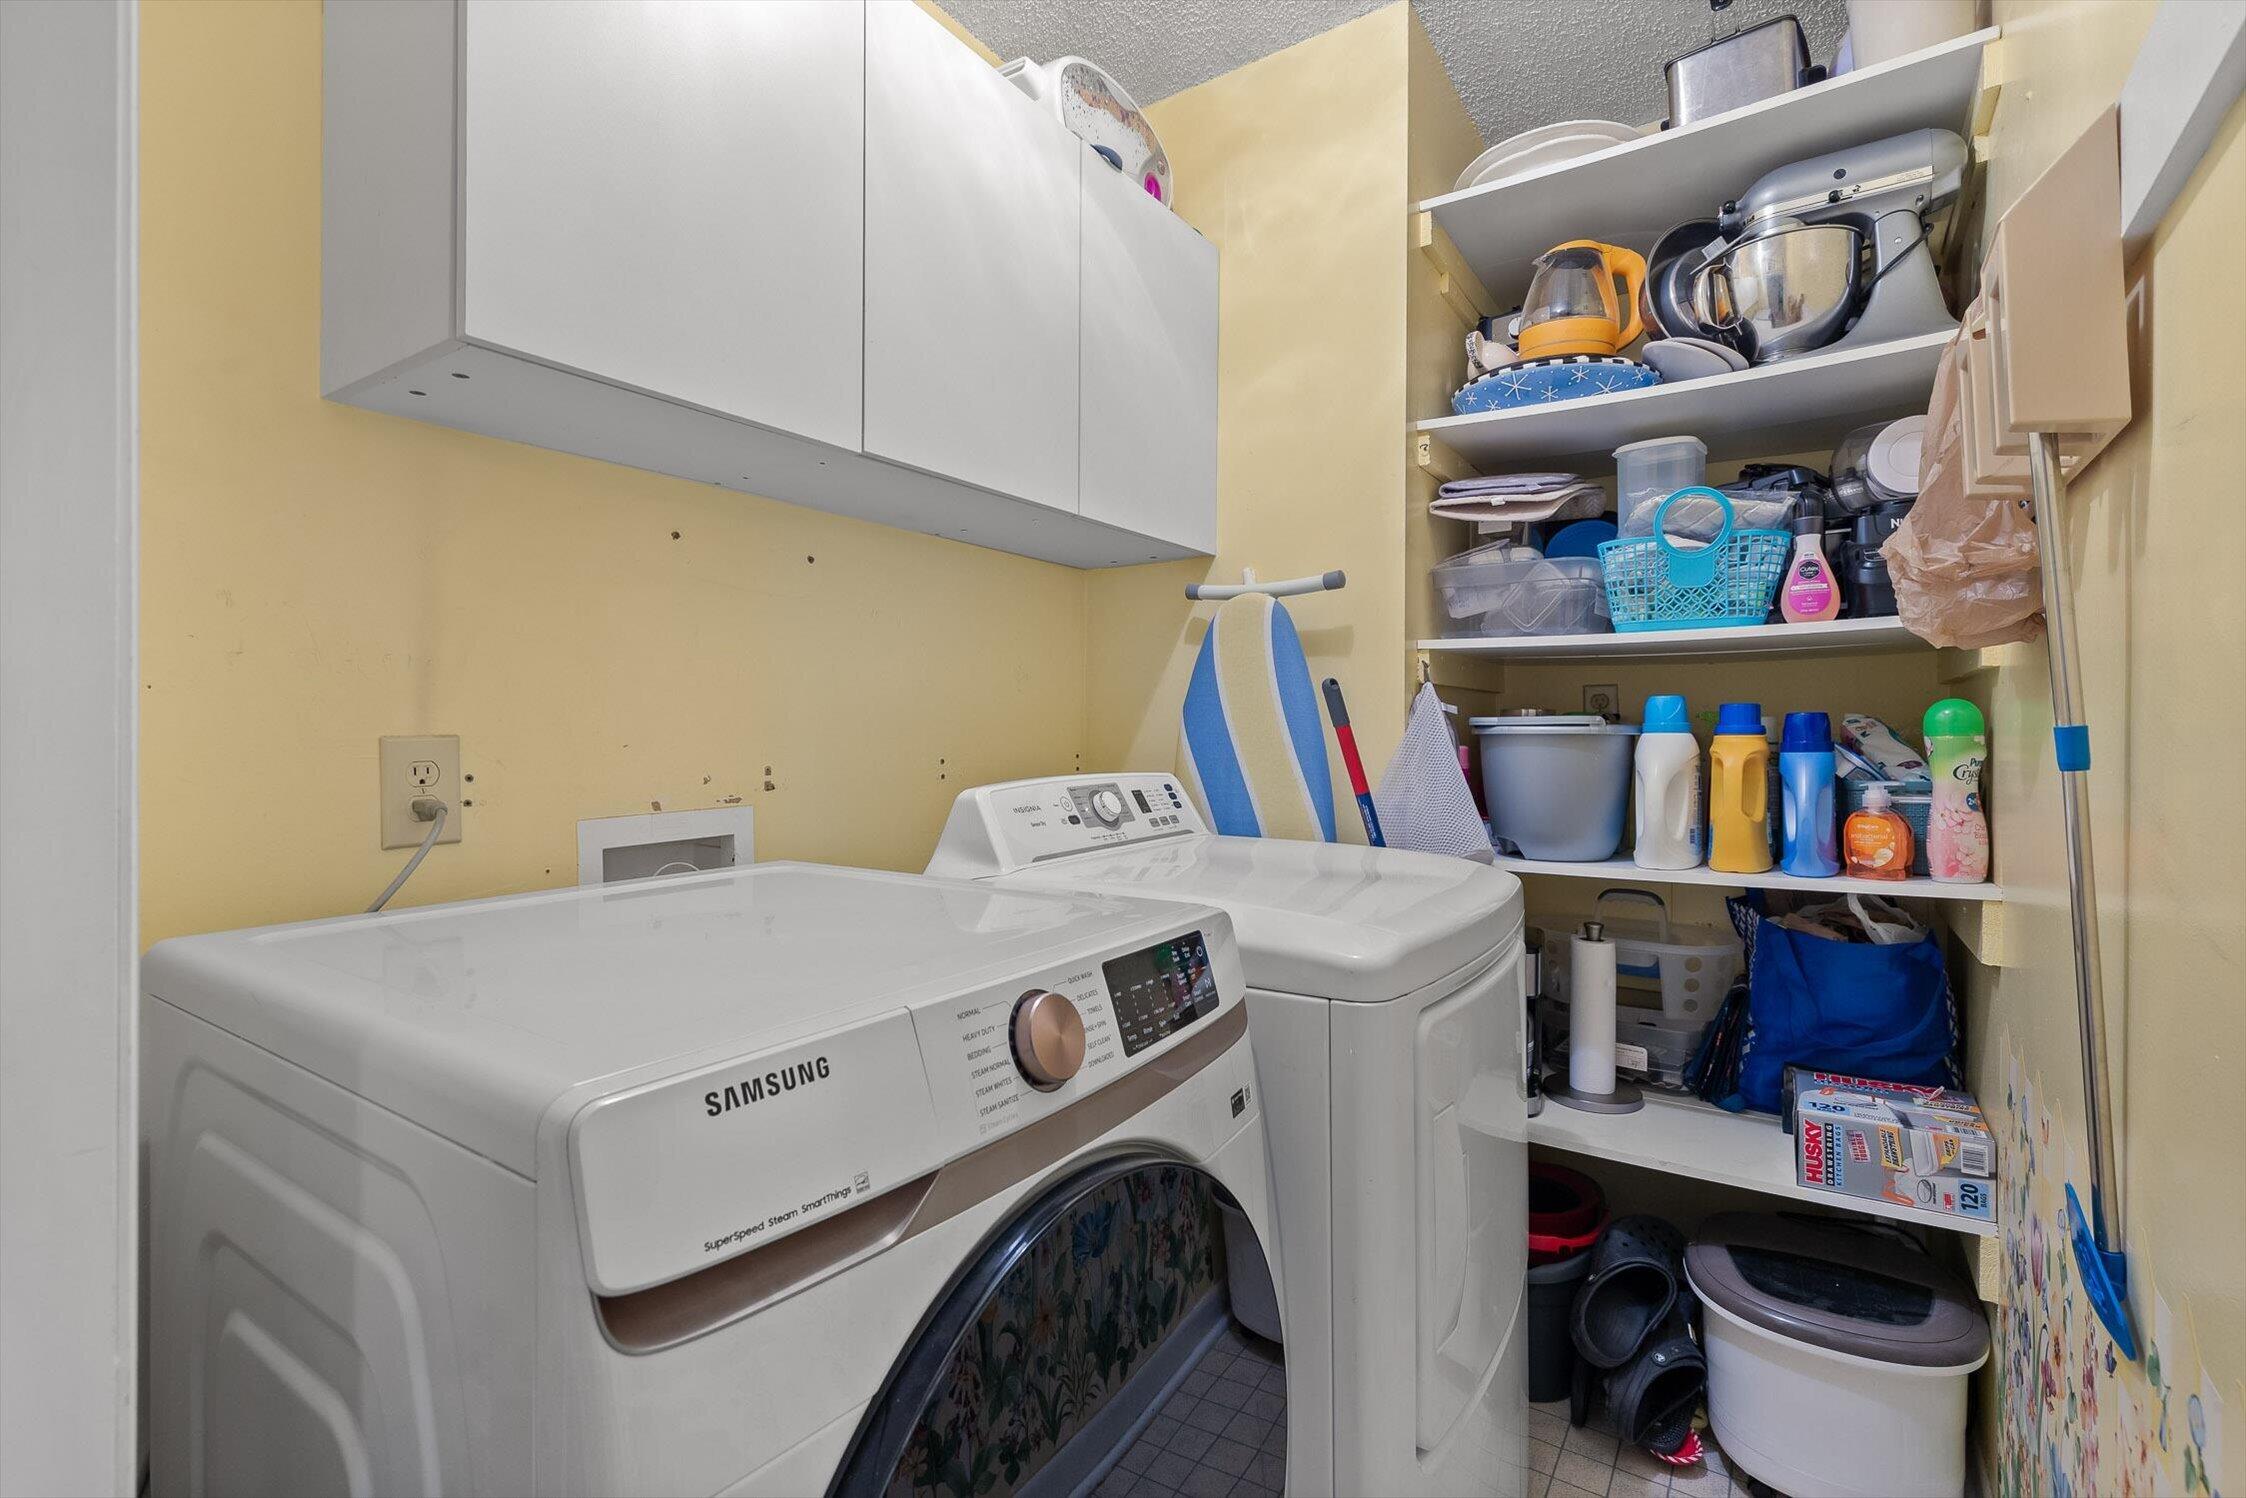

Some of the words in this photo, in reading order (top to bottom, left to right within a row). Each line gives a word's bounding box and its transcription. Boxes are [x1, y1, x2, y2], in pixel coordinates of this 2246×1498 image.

[1012, 805, 1041, 814] INSIGNIA
[1076, 988, 1099, 1001] DELICATES
[957, 1008, 981, 1020] NORMAL
[1086, 1004, 1103, 1015] TOWELS
[962, 1031, 980, 1042] HEAVY
[981, 1025, 996, 1036] DUTY
[967, 1046, 992, 1060] BEDDING
[971, 1067, 989, 1079] STEAM
[989, 1059, 1011, 1072] NORMAL
[704, 1056, 831, 1117] SAMSUNG
[975, 1085, 993, 1098] STEAM
[994, 1077, 1013, 1090] WHITES
[980, 1103, 997, 1117] STEAM
[997, 1094, 1020, 1109] SANITIZE
[1834, 1125, 1842, 1148] BAGS
[1804, 1118, 1824, 1185] HUSKY
[1825, 1124, 1834, 1186] DRAWSTRING
[1834, 1151, 1842, 1187] KITCHEN
[1959, 1183, 1979, 1211] 120
[1979, 1193, 1988, 1208] BAGS
[704, 1221, 766, 1252] SuperSpeed
[768, 1209, 799, 1227] Steam
[801, 1185, 852, 1214] SmartThings
